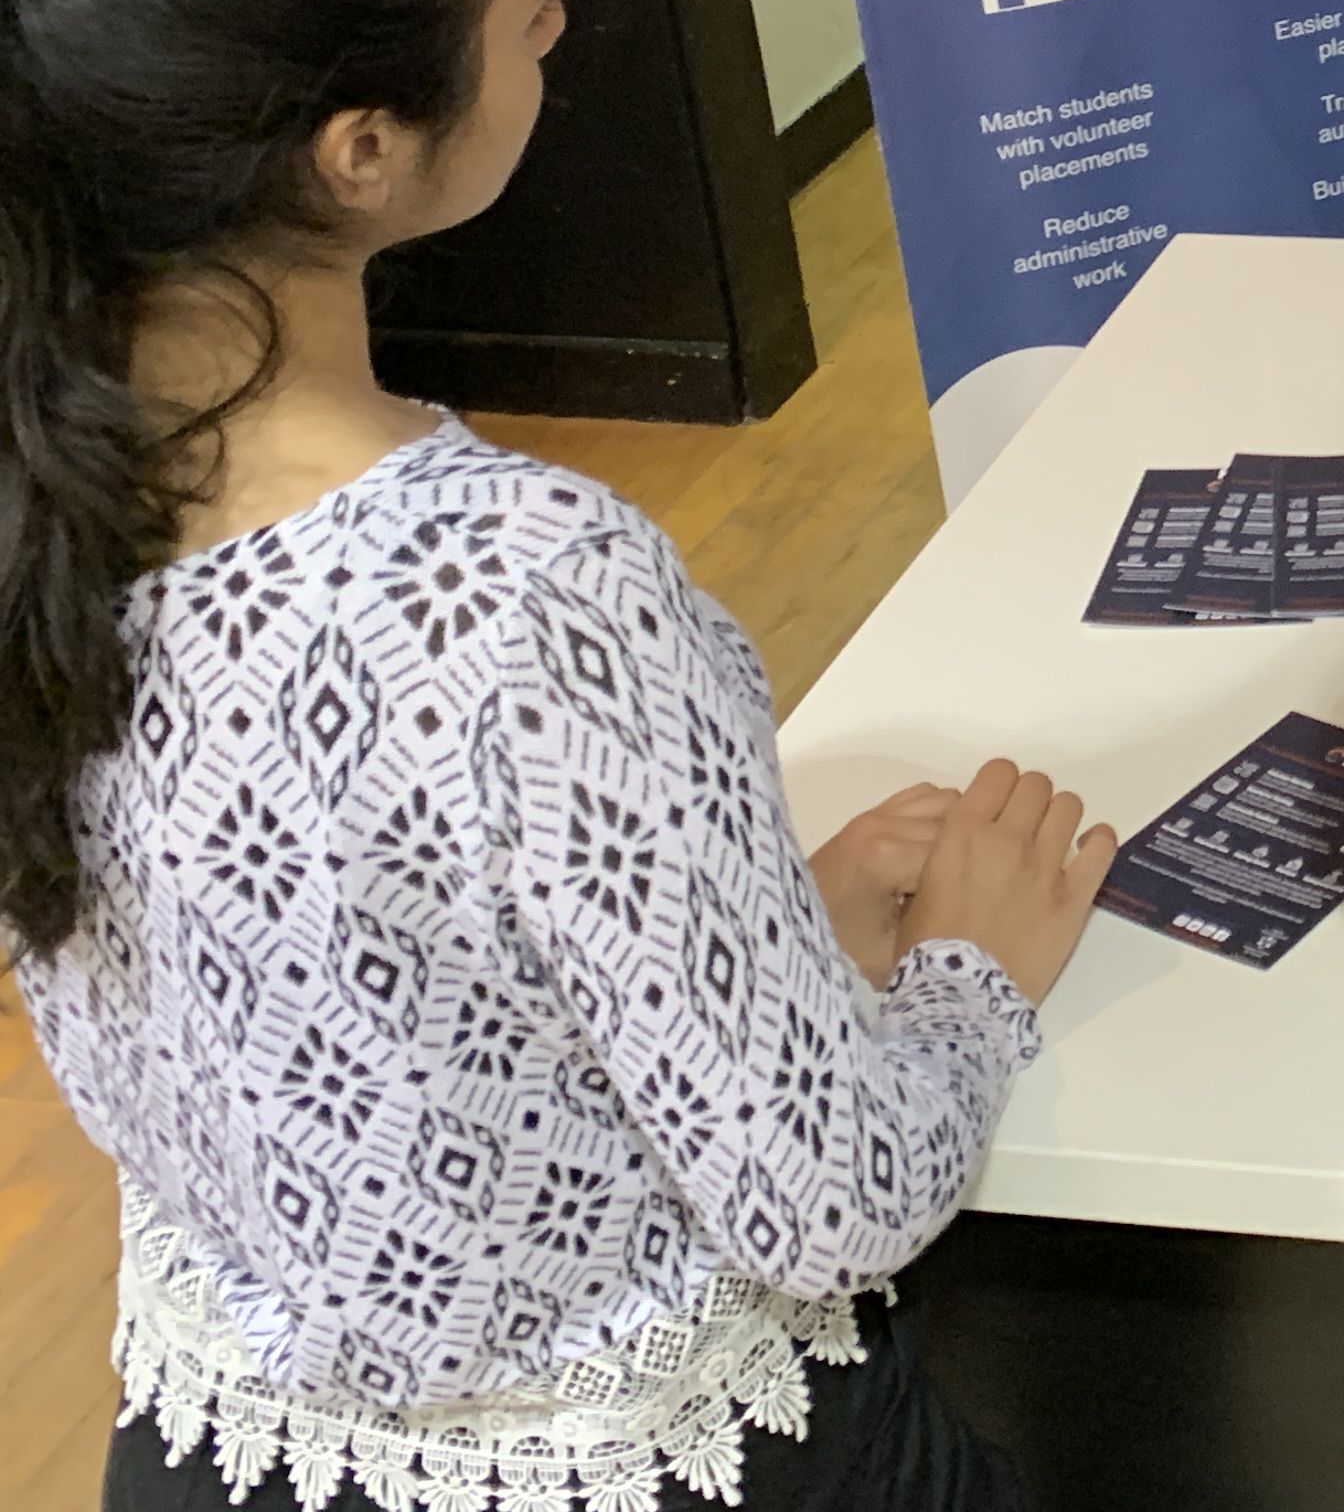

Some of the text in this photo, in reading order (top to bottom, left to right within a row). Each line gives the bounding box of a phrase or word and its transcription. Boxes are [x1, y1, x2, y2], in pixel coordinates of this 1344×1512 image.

[1274, 11, 1343, 41] Easier
[980, 82, 1154, 135] Match students
[996, 111, 1154, 160] with volunteer
[1018, 141, 1149, 190] placements
[1043, 203, 1131, 239] Reduce
[1013, 223, 1168, 274] administrative
[1073, 259, 1128, 289] work
